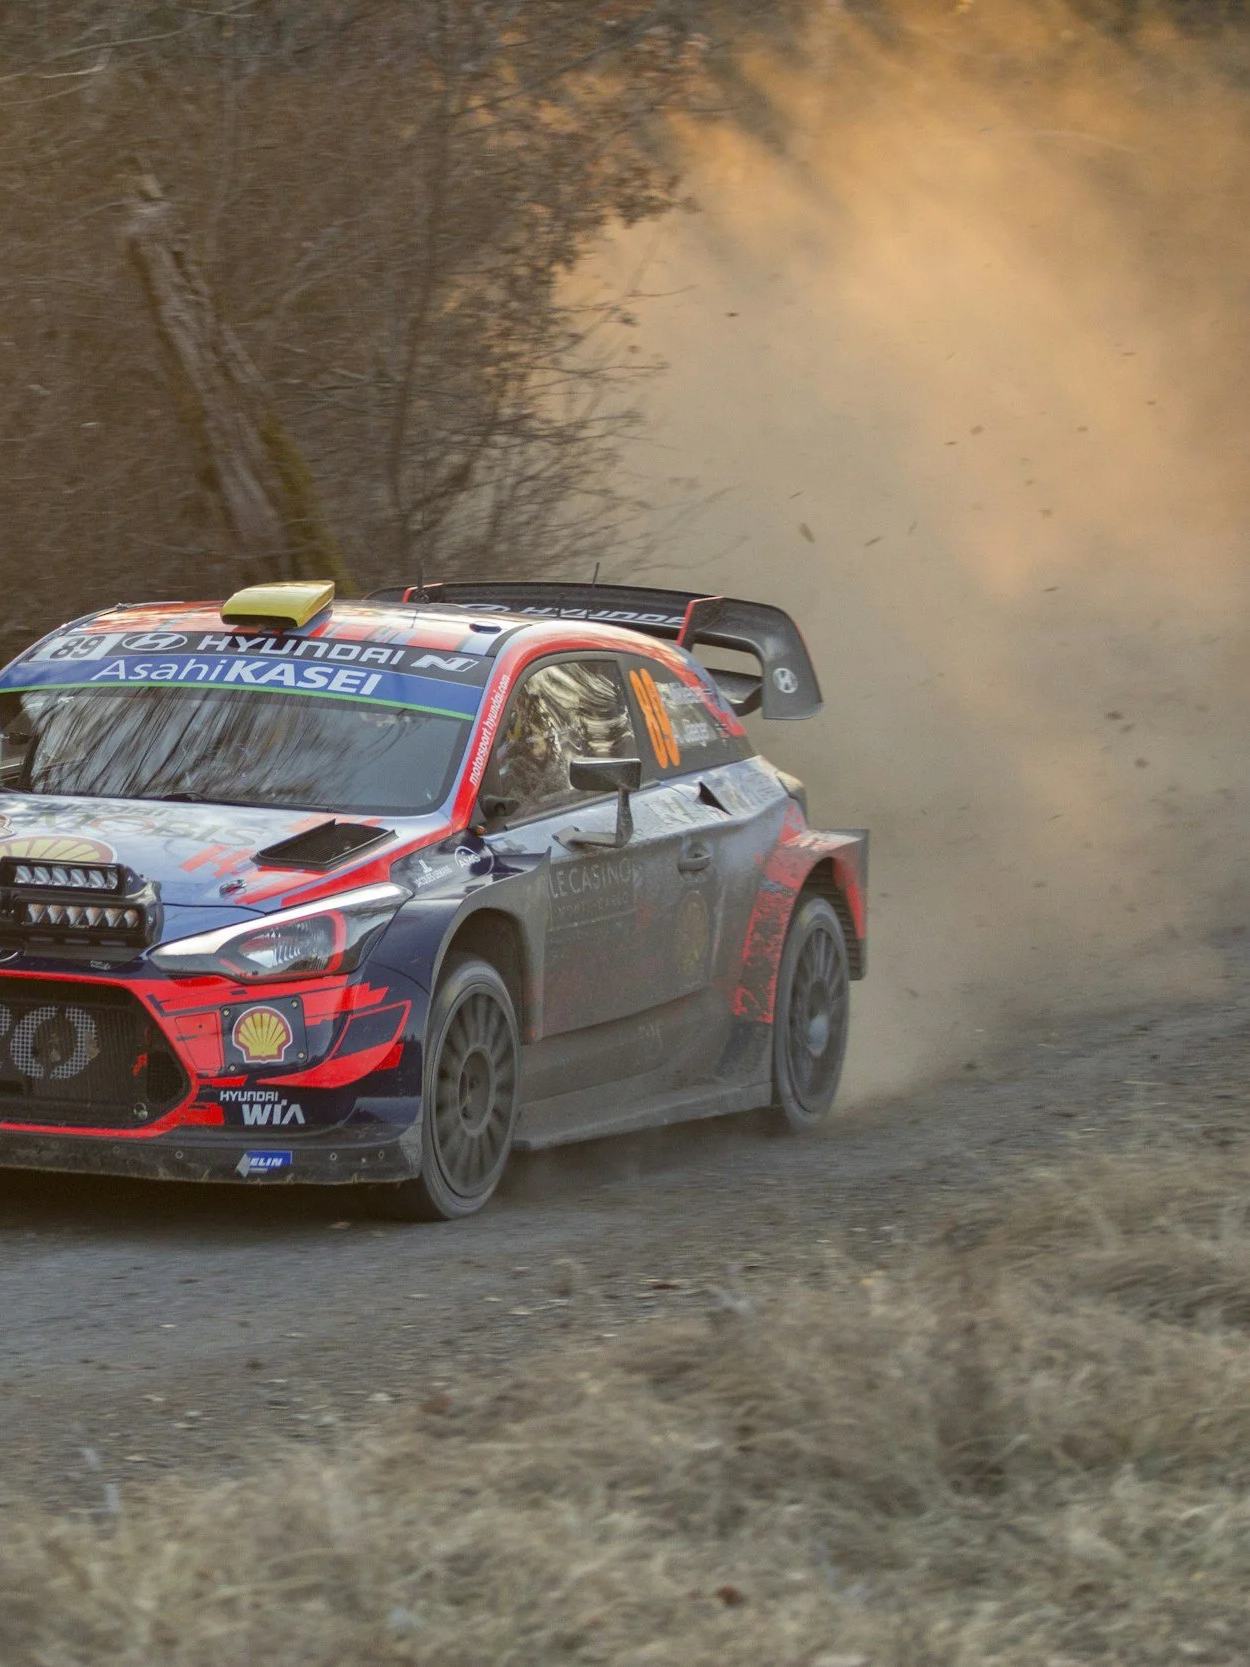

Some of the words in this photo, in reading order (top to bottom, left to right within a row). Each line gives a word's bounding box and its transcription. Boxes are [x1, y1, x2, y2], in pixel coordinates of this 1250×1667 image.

[520, 606, 686, 624] HYUNDA
[50, 635, 107, 659] 89
[196, 635, 405, 665] HYUNDAI
[90, 658, 382, 695] AsahiKASEI
[219, 1090, 279, 1102] HYUNDAI
